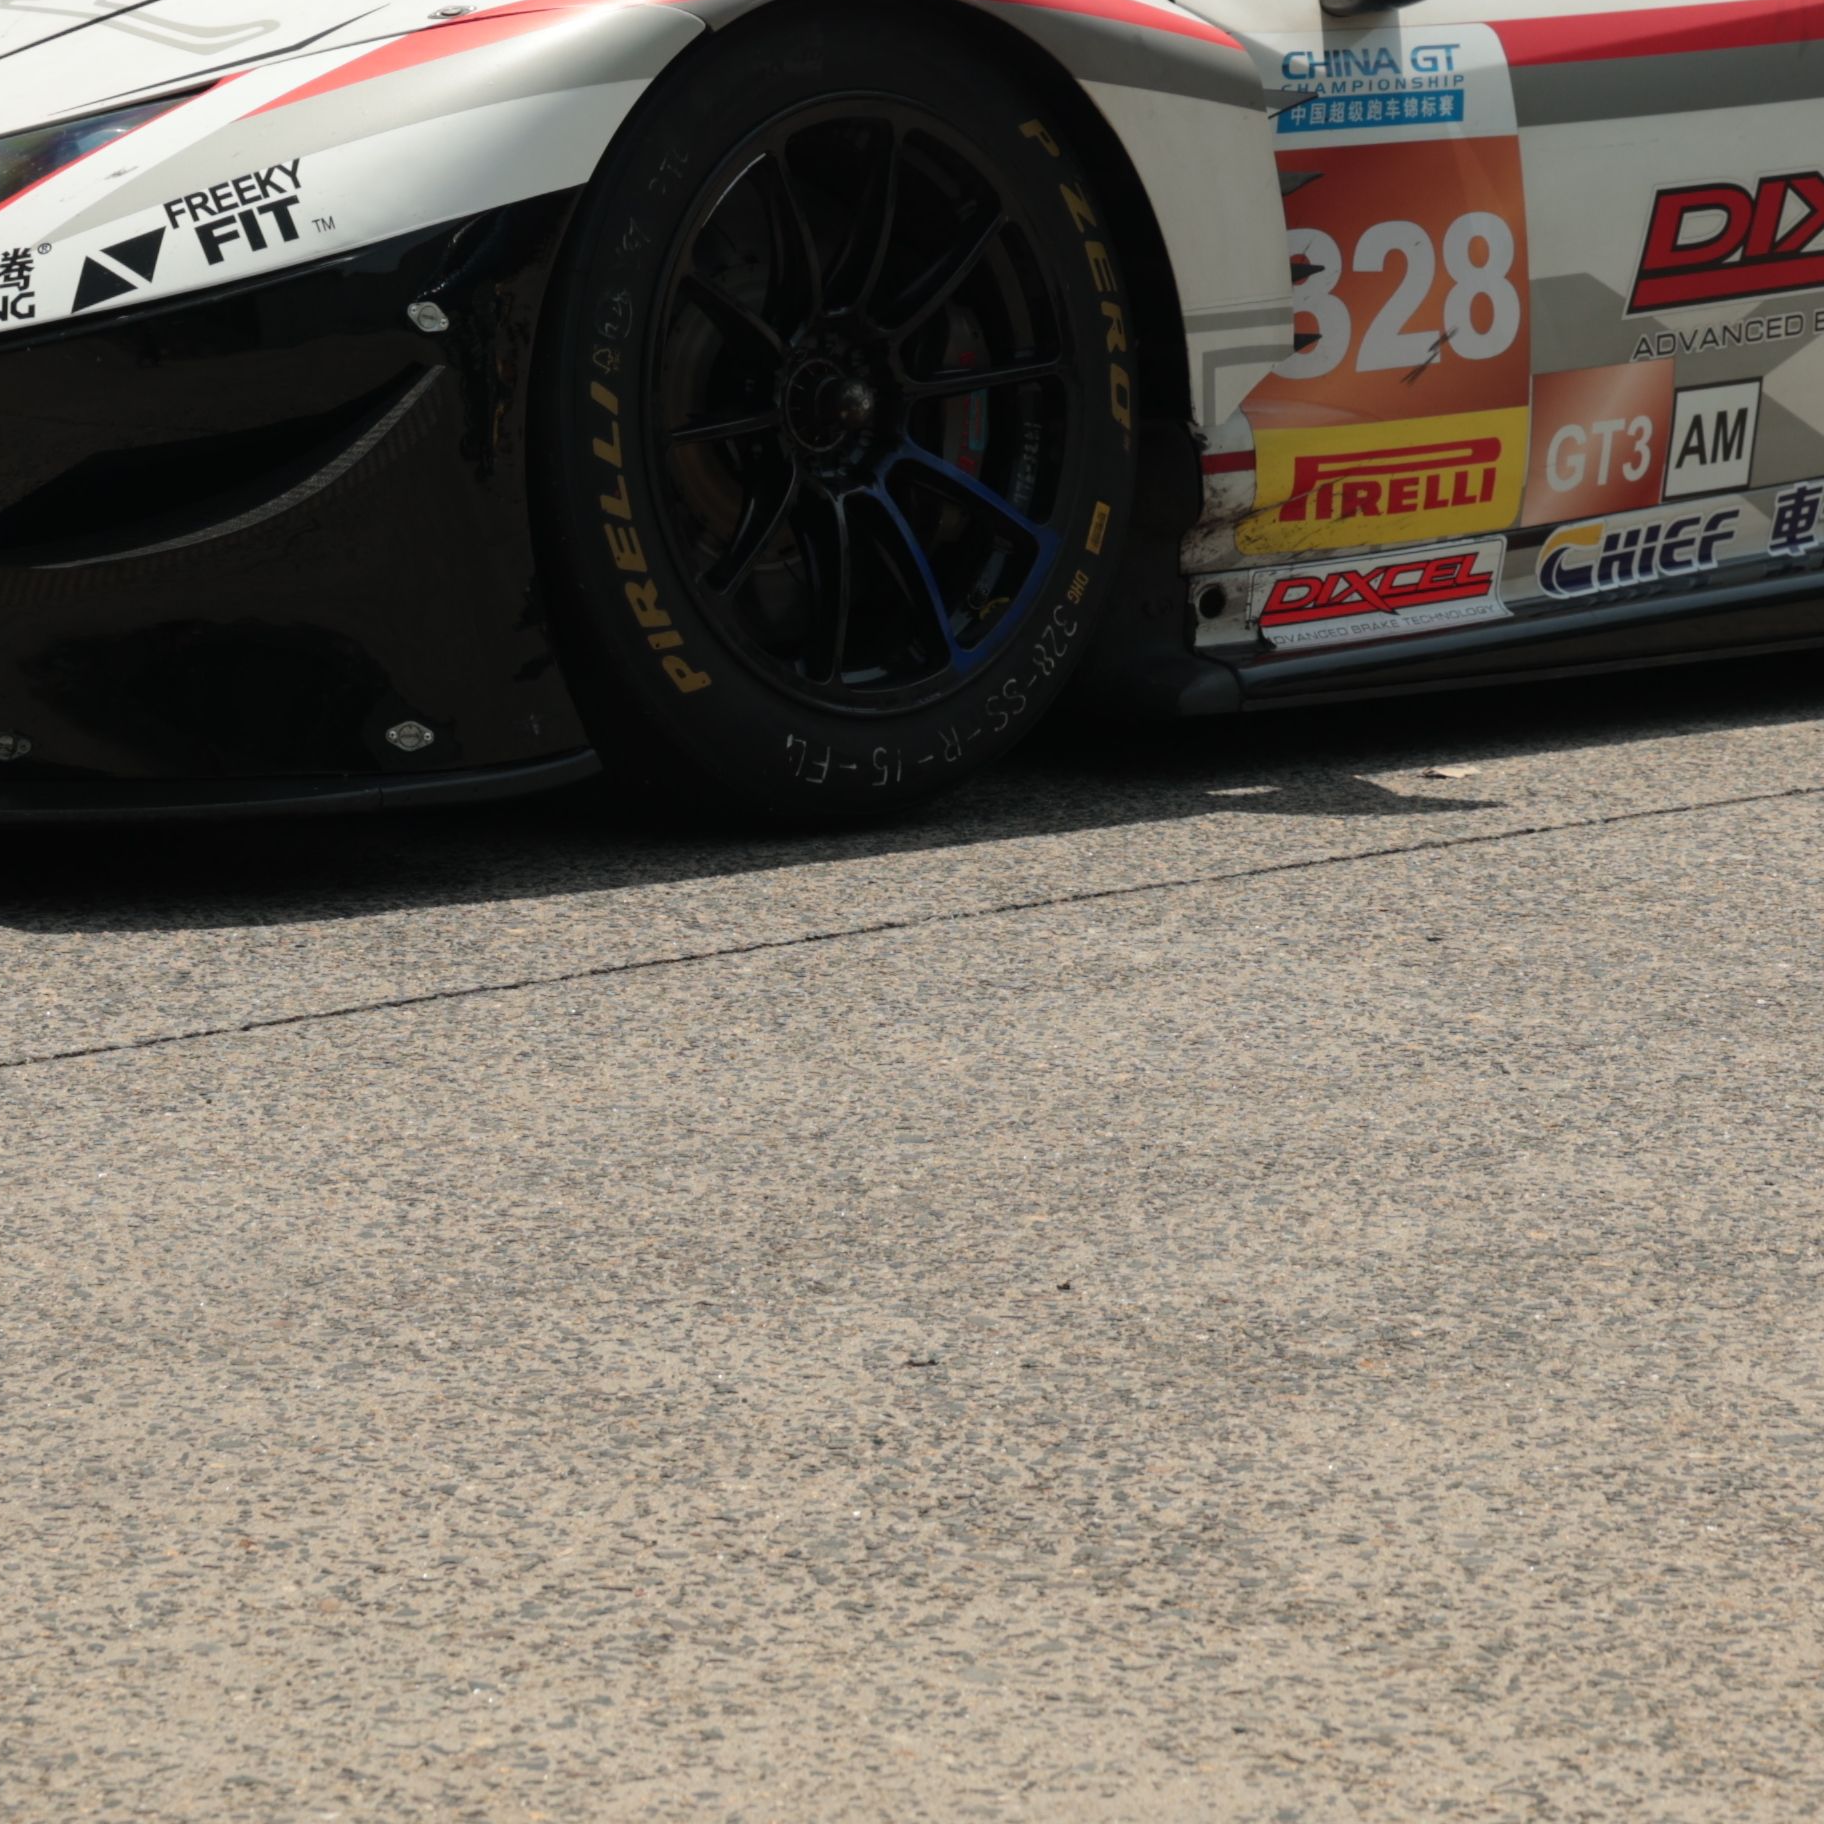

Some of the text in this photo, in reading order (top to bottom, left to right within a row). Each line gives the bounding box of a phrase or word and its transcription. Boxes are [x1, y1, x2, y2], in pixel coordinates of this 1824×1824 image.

[1281, 43, 1461, 80] CHINA GT
[1290, 94, 1455, 127] 中国超级跑车锦标赛
[163, 157, 303, 230] FREEKY
[193, 195, 302, 266] FIT
[1017, 116, 1133, 426] P ZERO
[1633, 312, 1804, 361] ADVANCED
[1545, 414, 1653, 494] GT3
[1675, 407, 1748, 470] AM
[1278, 436, 1503, 523] PIRELLI
[588, 379, 714, 696] PIRELLI
[1538, 508, 1741, 598] CHIEF
[1260, 551, 1495, 621] DIXCEL
[1352, 620, 1400, 636] BRAKE
[1403, 603, 1496, 629] TECHNOLOGY
